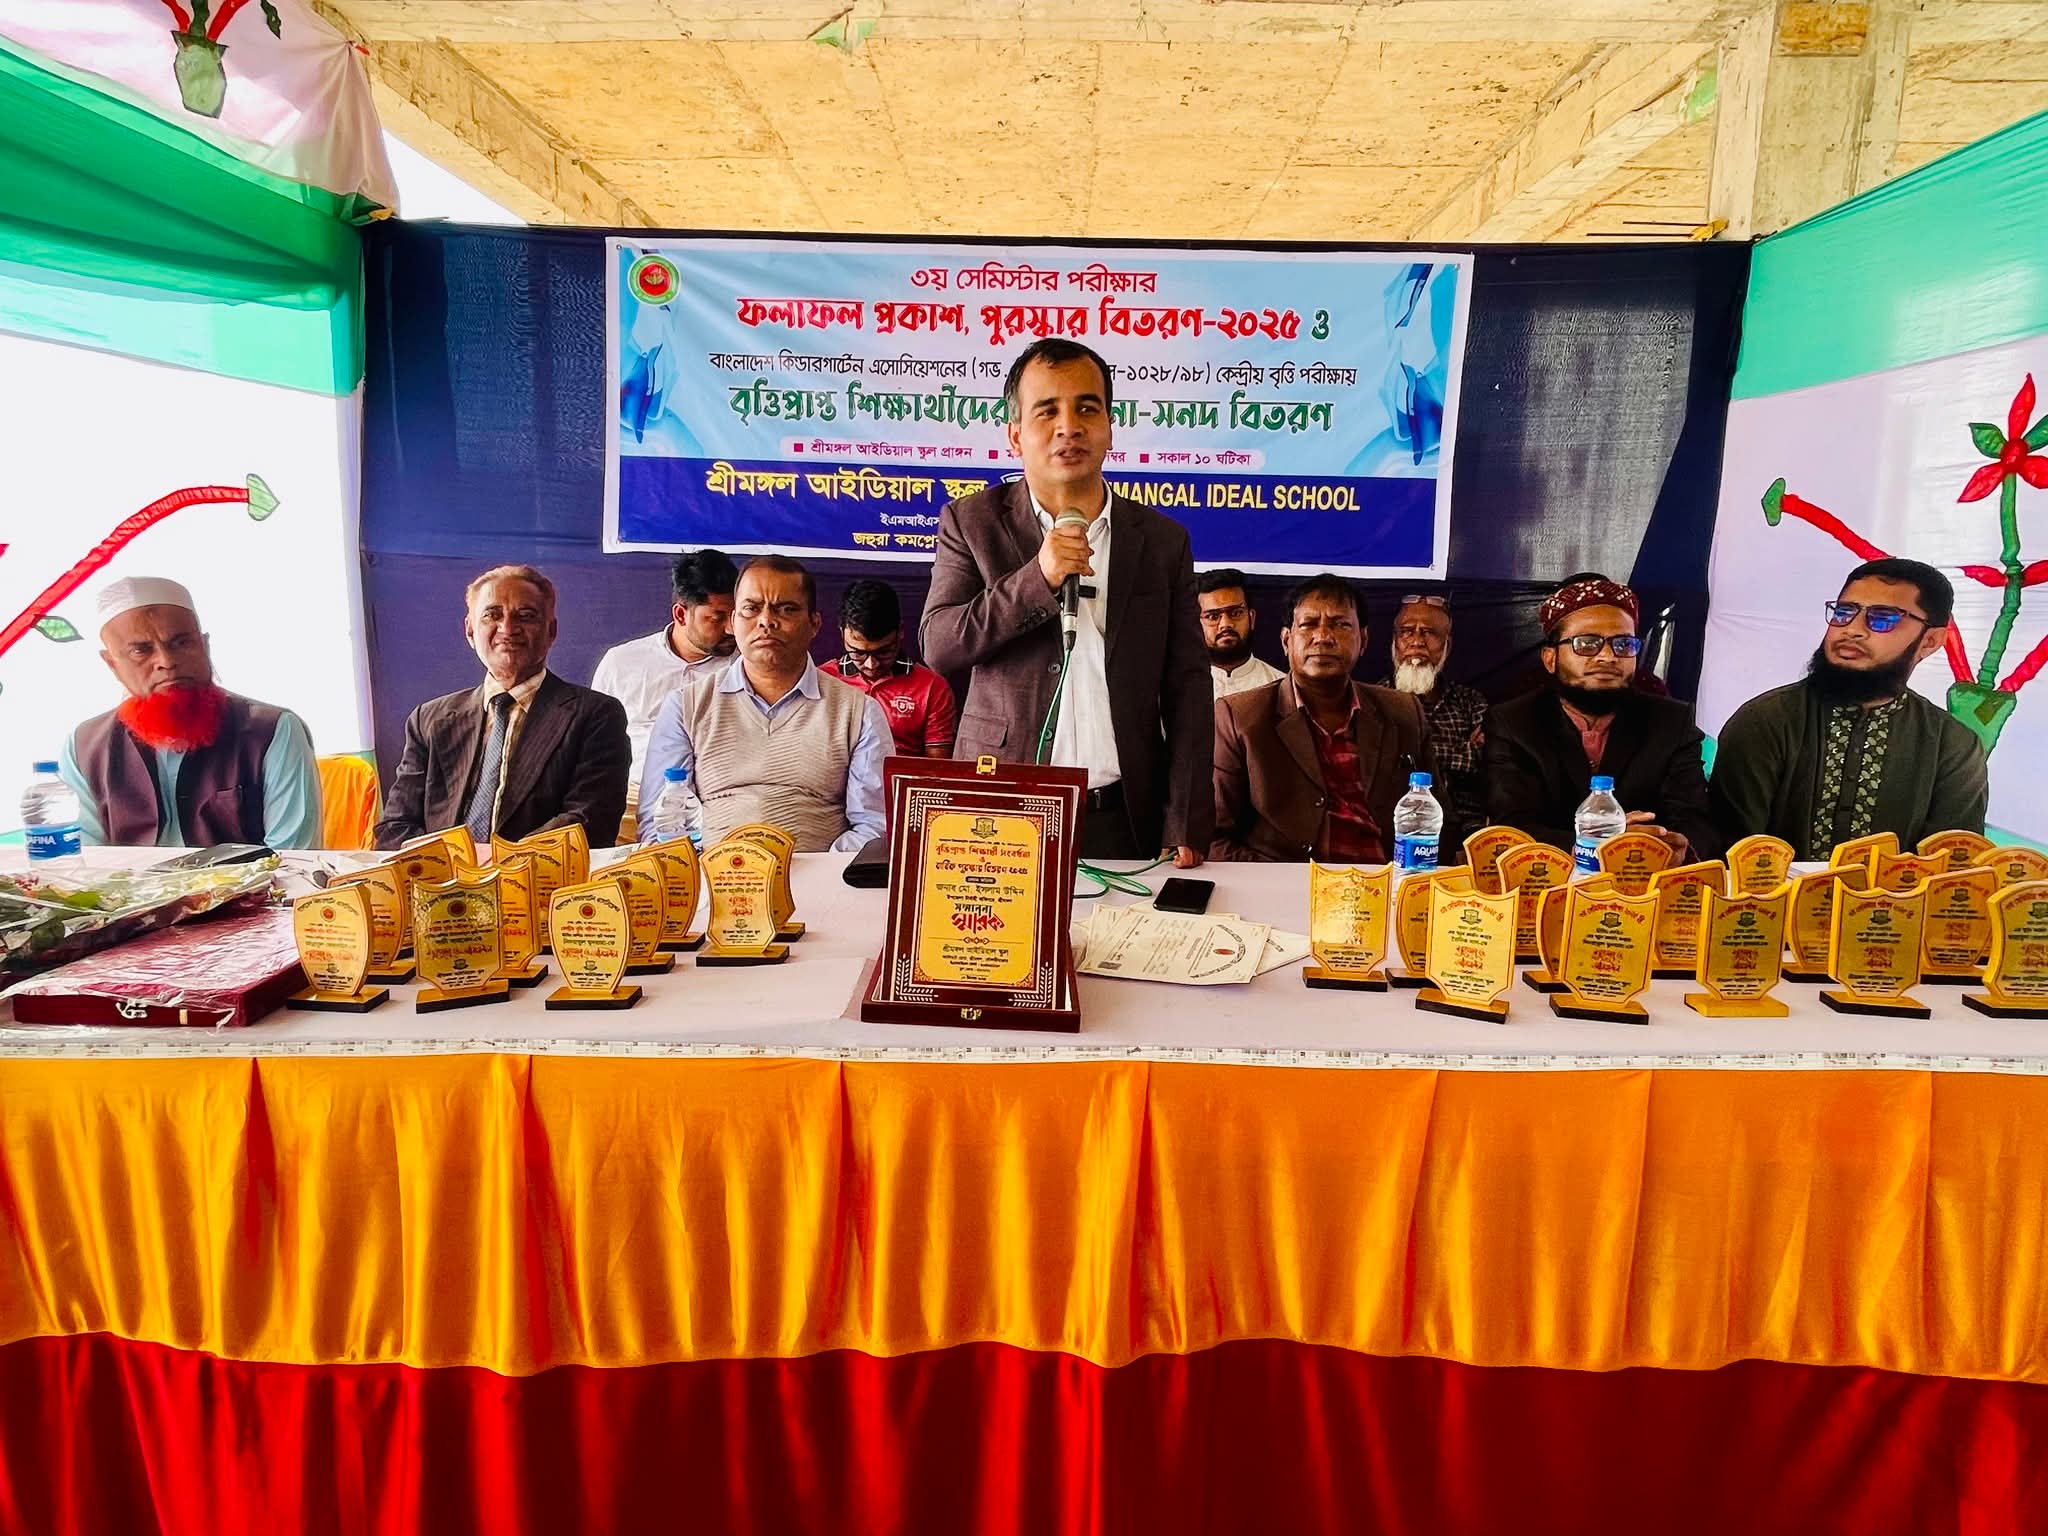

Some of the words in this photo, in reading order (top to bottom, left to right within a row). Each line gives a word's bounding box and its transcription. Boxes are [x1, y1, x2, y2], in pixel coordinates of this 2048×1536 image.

[911, 267, 948, 290] ৩য়
[956, 261, 1059, 291] সেমিস্টার
[1067, 264, 1157, 292] পরীক্ষার
[736, 297, 864, 330] ফলাফল
[873, 302, 969, 336] প্রকাশ,
[980, 305, 1089, 345] পুরস্কার
[1099, 295, 1301, 341] বিতরণ-২০২৫
[1311, 309, 1330, 341] ও
[710, 351, 774, 375] বাংলাদেশ
[778, 348, 864, 375] কিন্ডারগার্টেন
[868, 355, 967, 378] এসোসিয়েশনের
[1216, 360, 1264, 387] কেন্দ্রীয়
[1269, 362, 1295, 390] বৃত্তি
[1299, 361, 1357, 386] পরীক্ষায়
[729, 378, 837, 425] বৃত্তিপ্রাপ্ত
[846, 380, 1008, 429] শিক্ষার্থীদের
[1111, 399, 1220, 429] না-সনদ
[1230, 390, 1334, 432] বিতরণ
[810, 439, 851, 455] শ্রীমঙ্গল
[856, 442, 913, 457] আইডিয়াল
[917, 446, 936, 461] স্কুল
[1157, 452, 1191, 464] সকাল
[1195, 453, 1211, 465] ১০
[1216, 451, 1251, 466] ঘটিকা
[705, 461, 800, 498] শ্রীমঙ্গল
[805, 466, 935, 504] আইডিয়াল
[1207, 484, 1268, 509] IDEAL
[1273, 486, 1361, 512] SCHOOL
[852, 532, 890, 549] জহুরা
[894, 533, 939, 549] কমপ্লে
